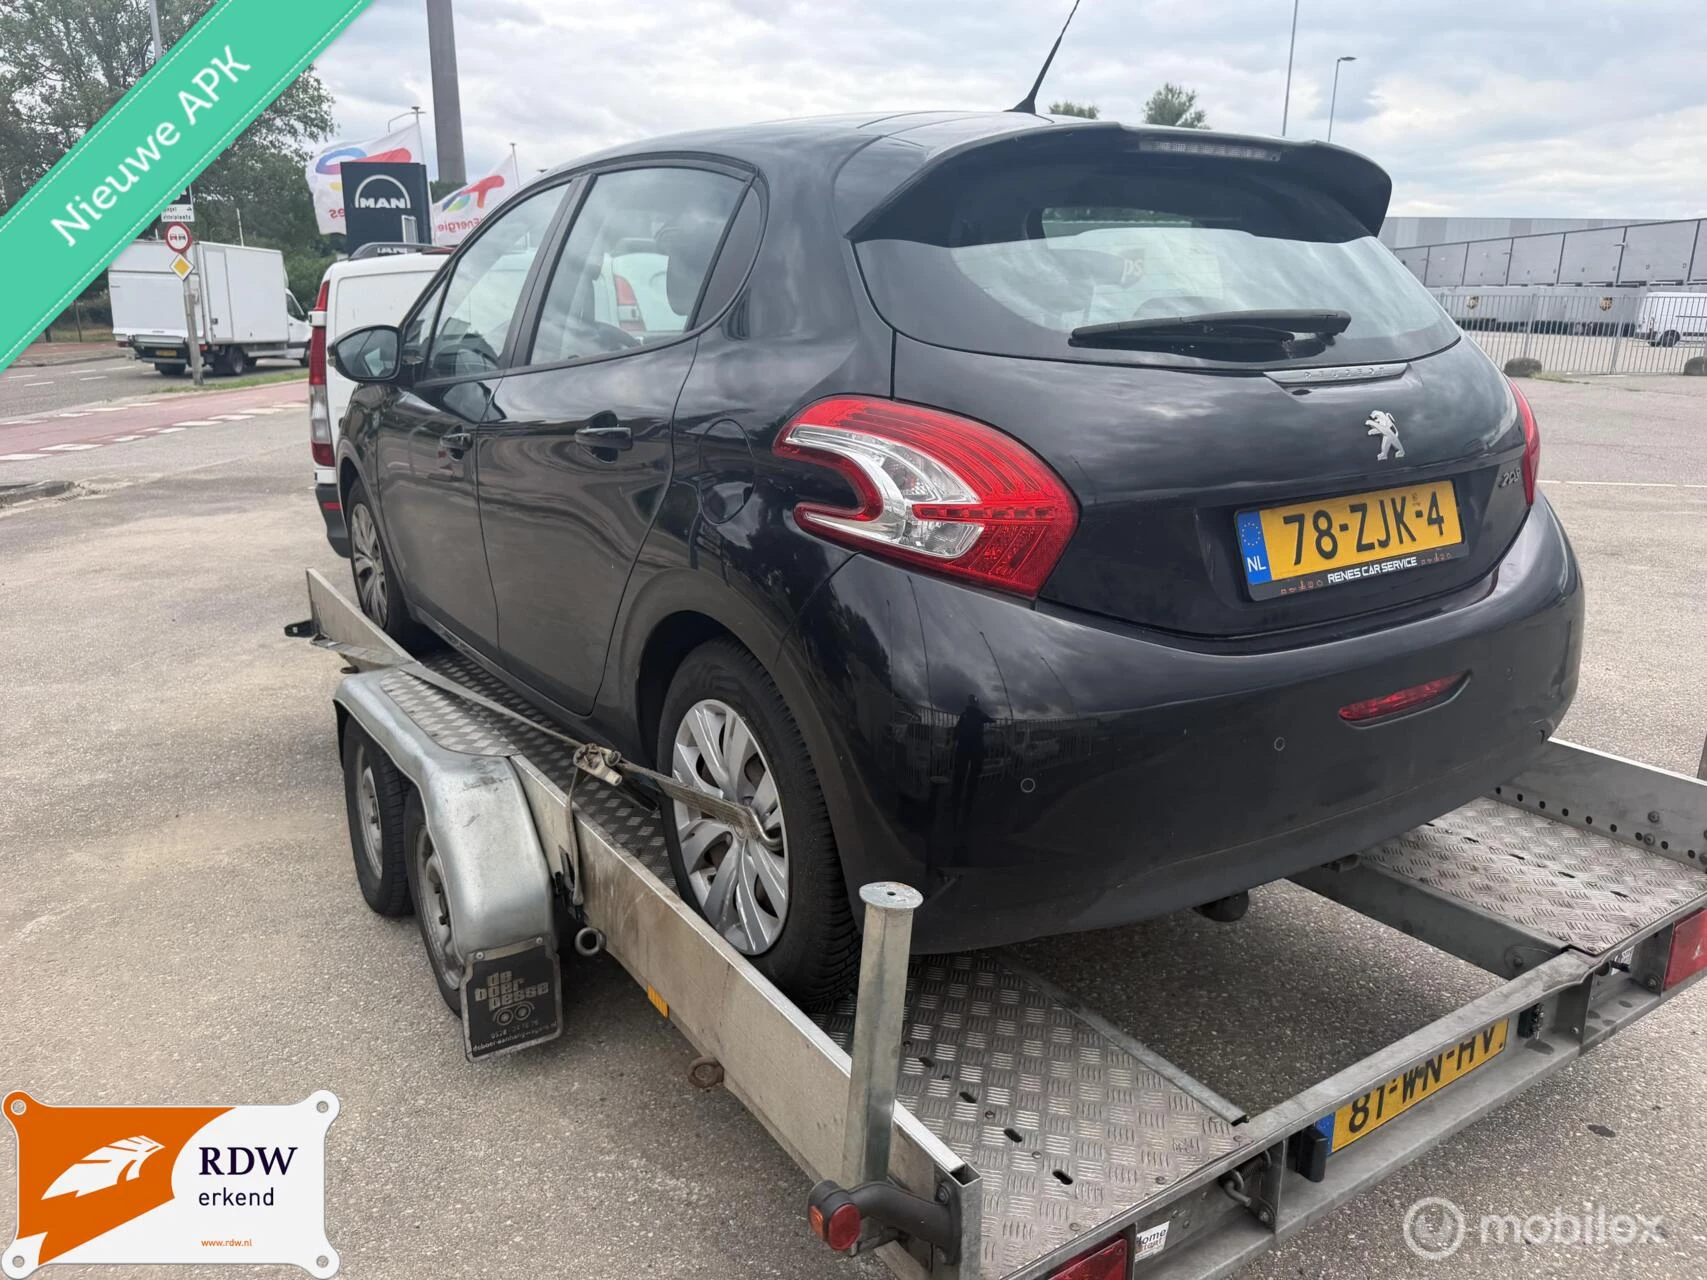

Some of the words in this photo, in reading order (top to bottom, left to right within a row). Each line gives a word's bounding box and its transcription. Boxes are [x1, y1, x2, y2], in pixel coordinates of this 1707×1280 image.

[359, 197, 406, 209] MAN
[1283, 490, 1444, 566] 78-ZJK-4
[1247, 556, 1267, 573] NL
[1327, 568, 1361, 584] RENES
[1362, 564, 1382, 578] CAR
[1382, 556, 1418, 573] SERVICE
